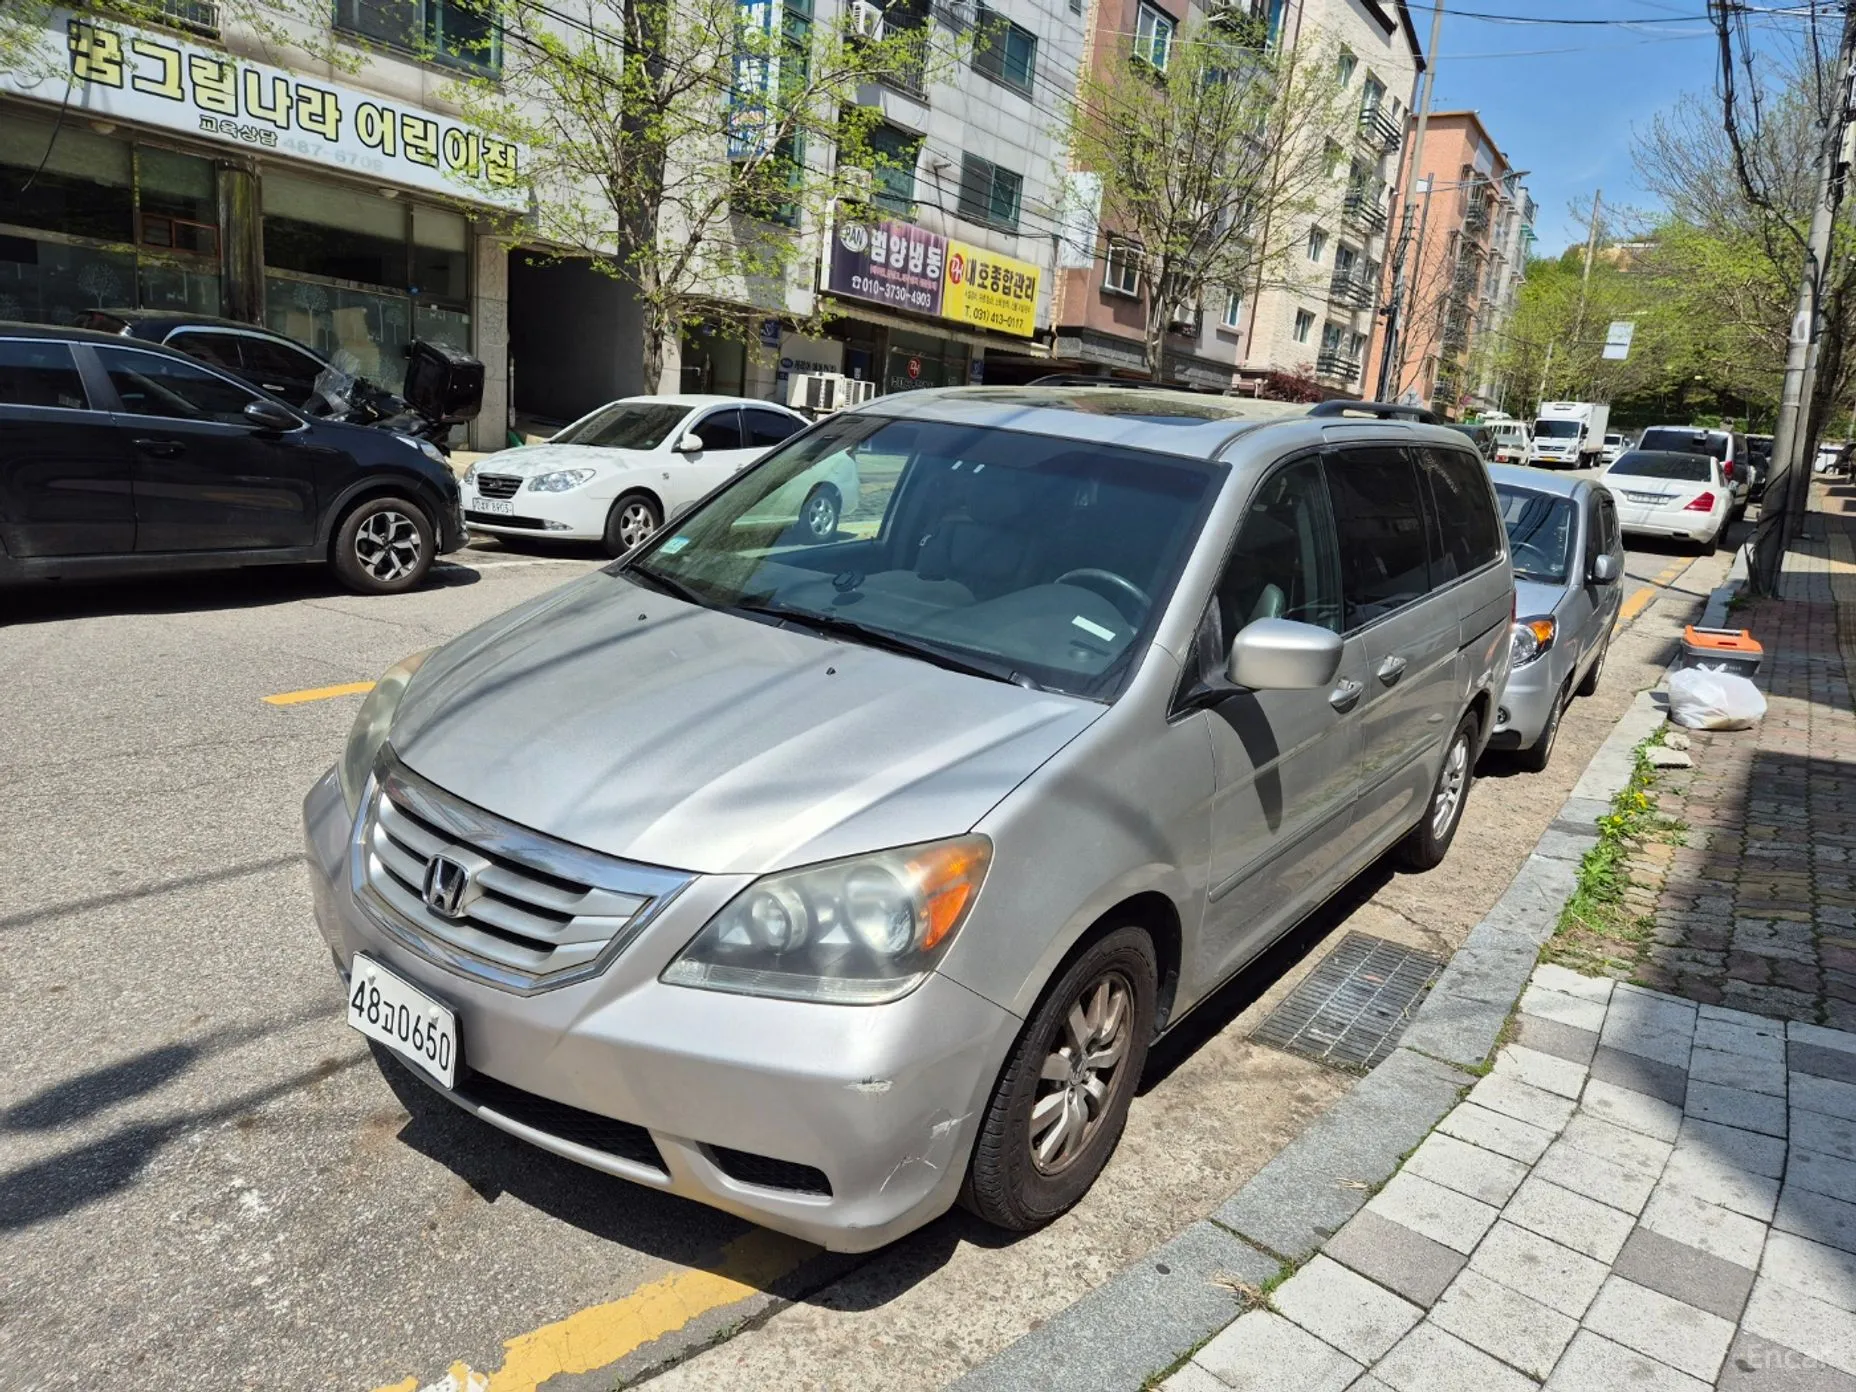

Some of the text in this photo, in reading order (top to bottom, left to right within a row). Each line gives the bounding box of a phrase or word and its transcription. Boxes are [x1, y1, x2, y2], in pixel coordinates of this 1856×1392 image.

[67, 18, 519, 188] 꿈그림나라 어린이집
[199, 114, 279, 147] 교육상담
[871, 228, 942, 279] 범양냉동
[862, 277, 932, 308] 010-3730-4903
[351, 980, 450, 1071] 48고0650
